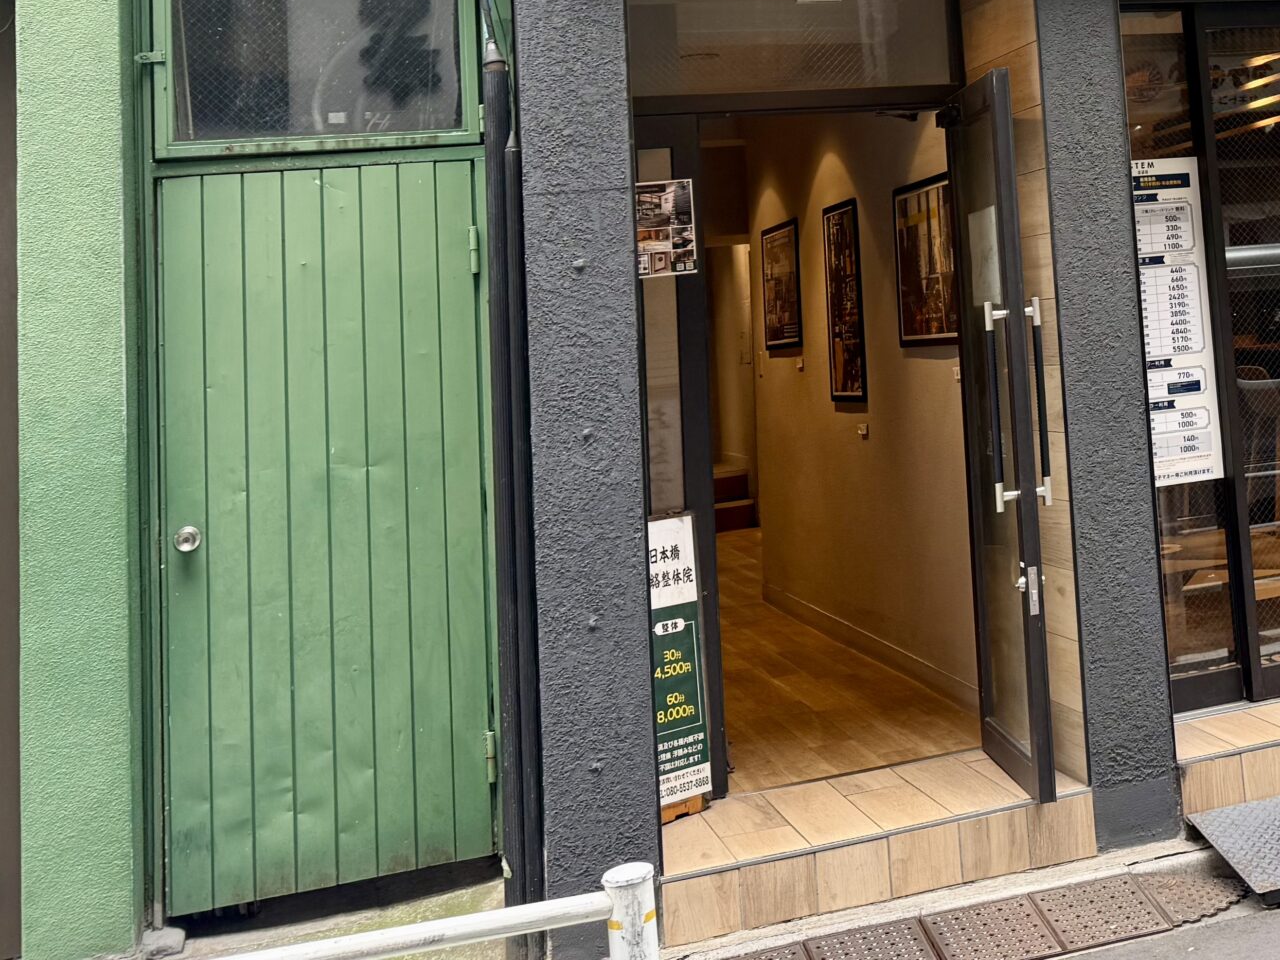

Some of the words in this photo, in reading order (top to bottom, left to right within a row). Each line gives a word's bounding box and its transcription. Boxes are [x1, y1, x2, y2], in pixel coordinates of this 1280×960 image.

[661, 621, 679, 633] 整体
[663, 649, 682, 662] 30分
[654, 661, 692, 680] 4,500円
[666, 692, 685, 705] 60分
[656, 704, 695, 724] 8,000円
